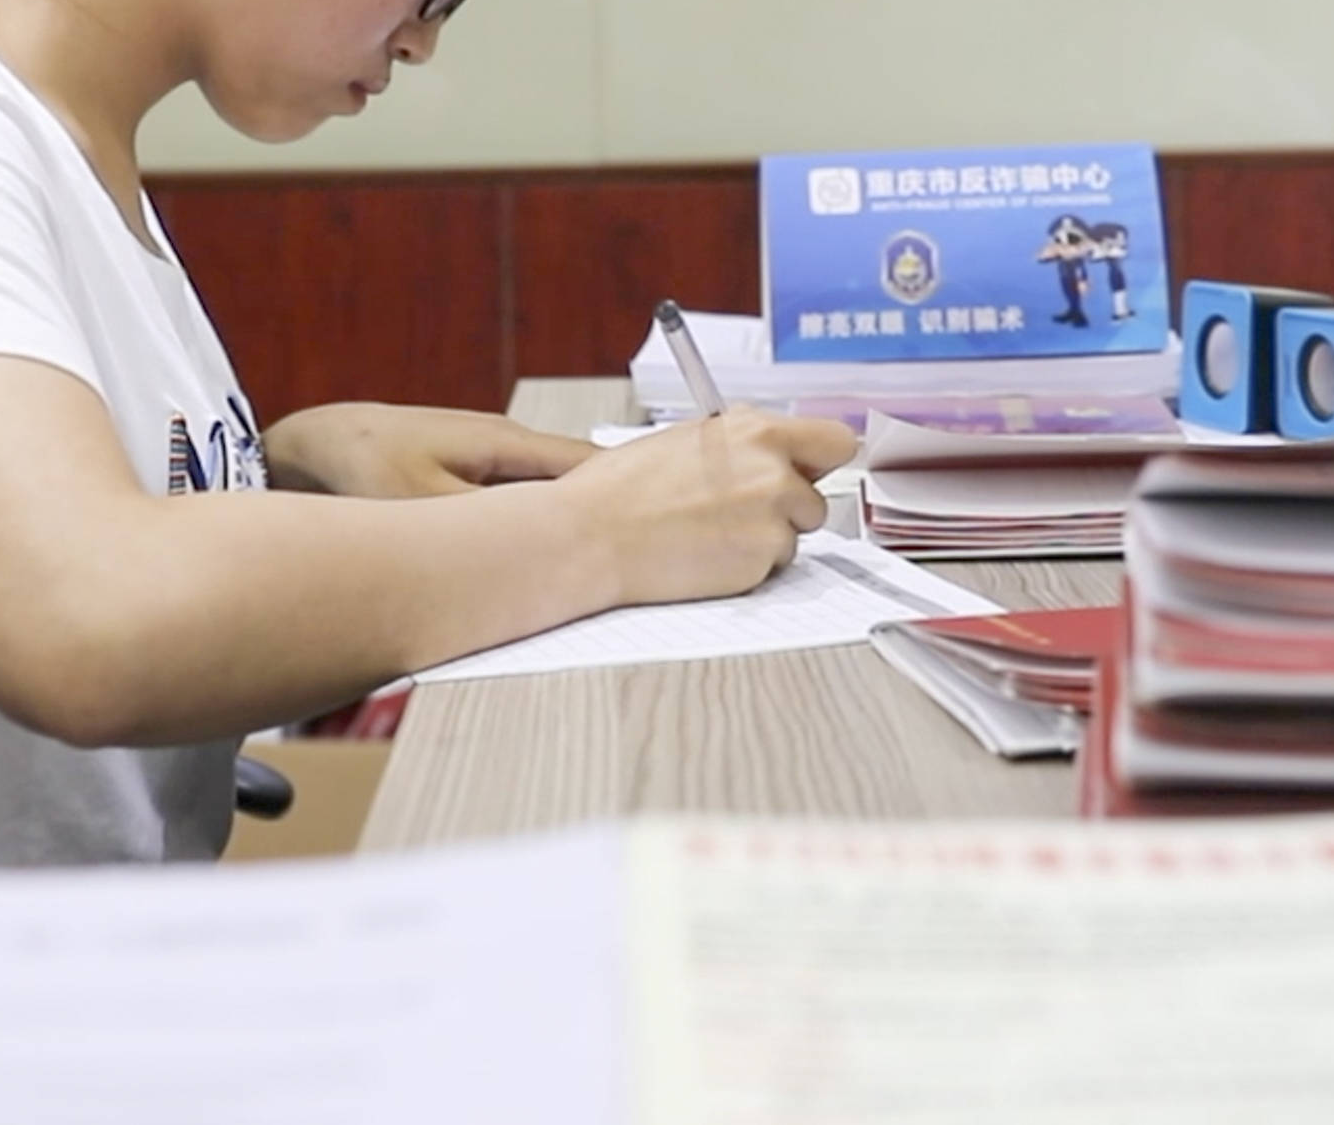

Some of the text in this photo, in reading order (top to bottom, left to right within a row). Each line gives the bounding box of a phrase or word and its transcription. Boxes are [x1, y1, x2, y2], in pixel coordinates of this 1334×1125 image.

[867, 163, 1111, 197] 重庆市反诈骗中心
